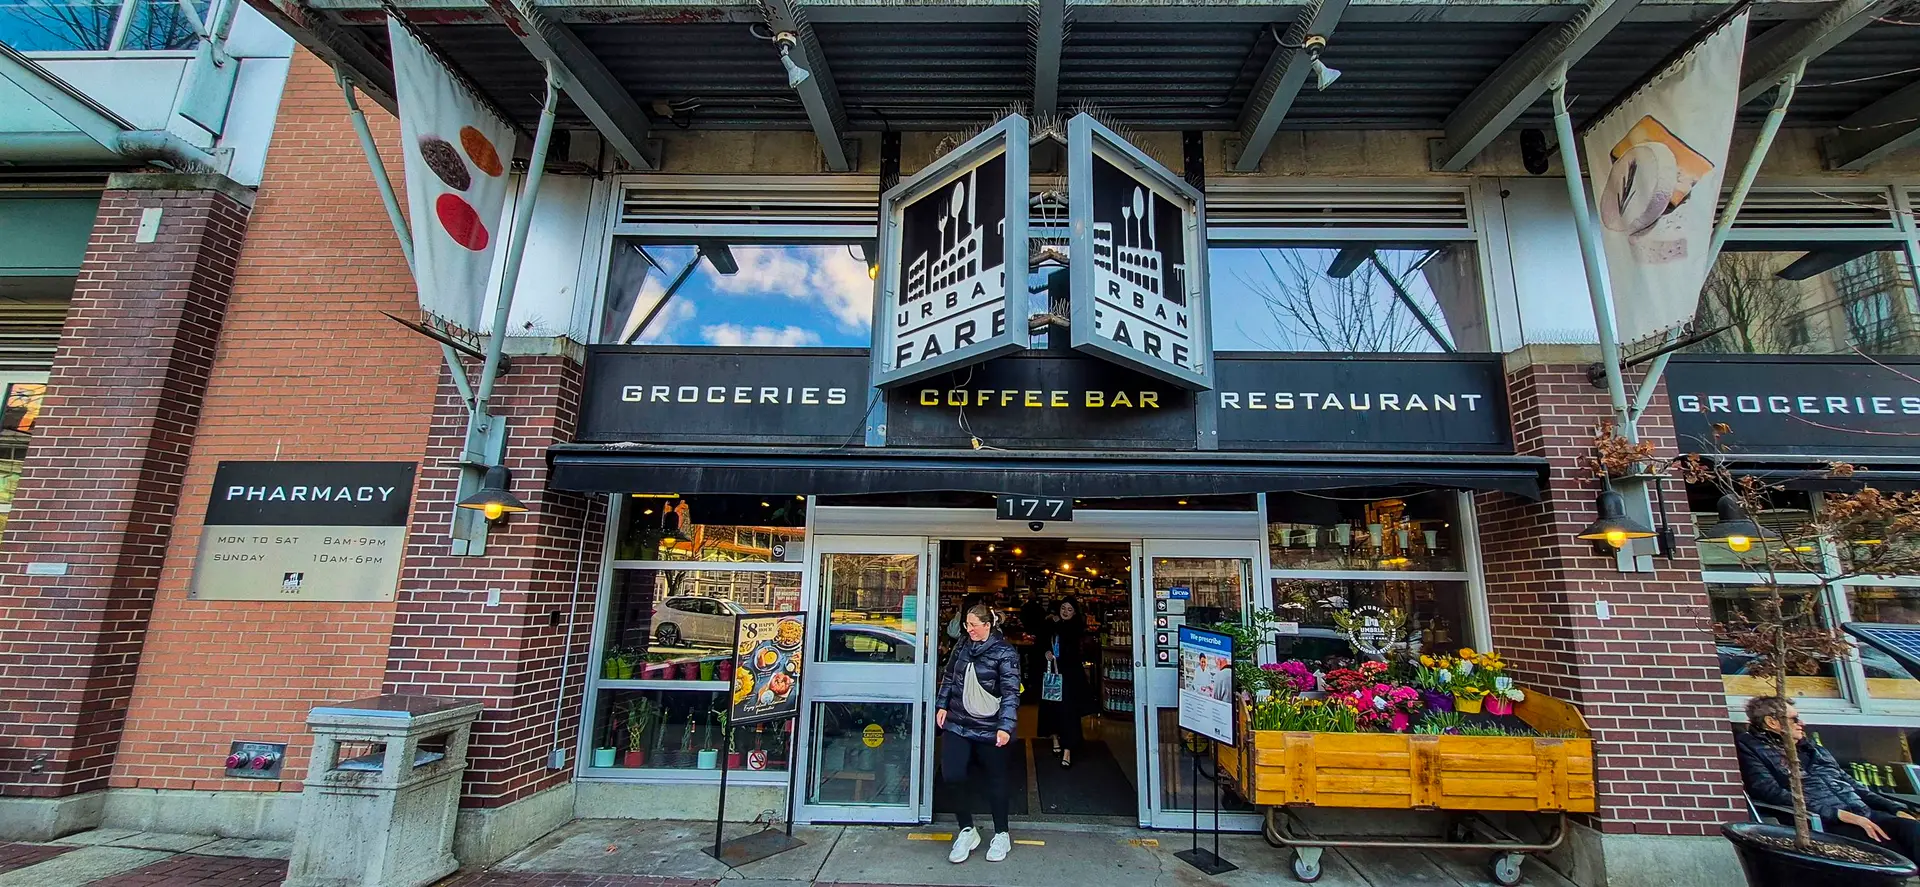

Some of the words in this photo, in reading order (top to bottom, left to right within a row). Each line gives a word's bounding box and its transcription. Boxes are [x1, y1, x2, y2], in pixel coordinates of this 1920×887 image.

[621, 385, 847, 405] GROCERIES
[920, 389, 1069, 407] COFFEE
[1085, 390, 1160, 408] BAR
[1220, 392, 1482, 411] RESTAURANT
[1677, 395, 1920, 414] GROCERIES
[226, 486, 395, 502] PHARMACY
[1005, 498, 1064, 517] 177
[217, 536, 245, 544] MON
[252, 536, 269, 544] TO
[275, 536, 300, 545] SAT
[323, 536, 387, 547] 8AM-9PM
[213, 554, 266, 562] SUNDAY
[312, 554, 383, 564] 10AM-6PM
[1352, 605, 1389, 618] FEATURING
[1190, 632, 1198, 640] We
[1198, 635, 1222, 646] prescribe
